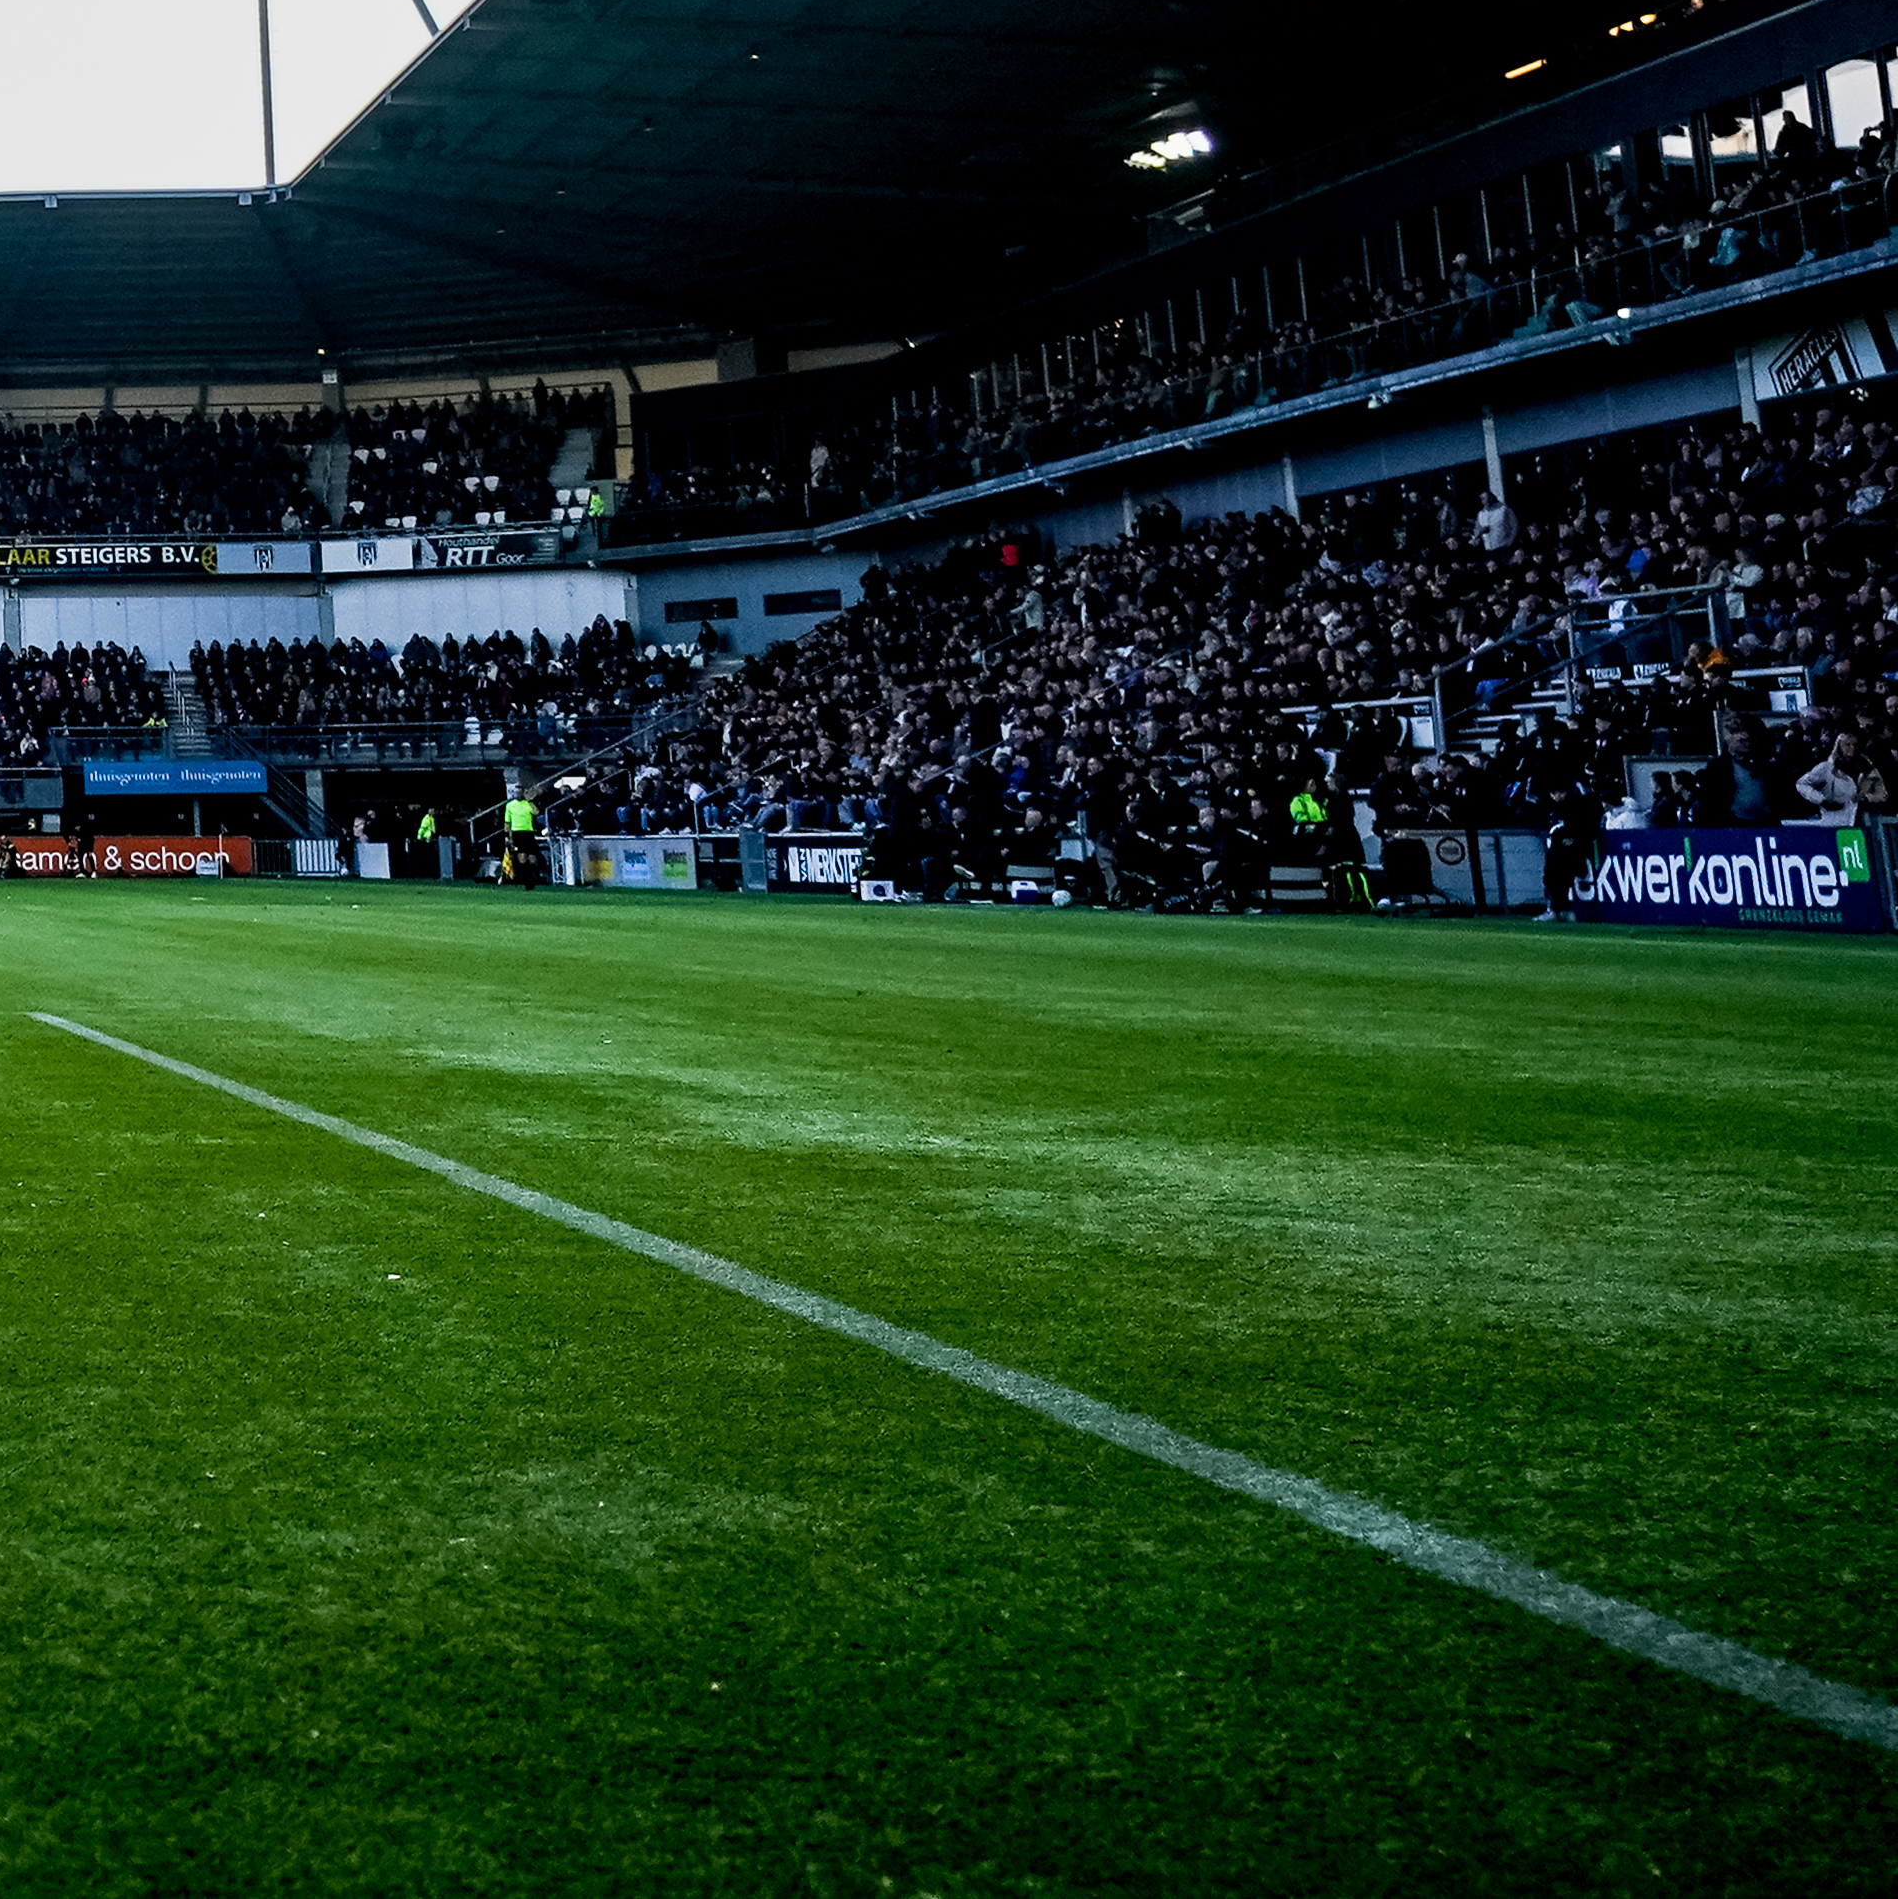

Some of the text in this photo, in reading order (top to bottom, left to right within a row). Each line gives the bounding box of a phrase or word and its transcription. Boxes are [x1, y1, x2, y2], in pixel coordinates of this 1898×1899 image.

[438, 535, 501, 548] Houthandel
[55, 546, 152, 565] STEIGERS
[162, 545, 201, 564] B.V.
[445, 545, 526, 567] RTT Goor
[89, 769, 171, 787] thuisgenoten
[179, 768, 262, 786] thuisgenoten
[103, 845, 122, 871] &
[129, 846, 230, 872] schoon
